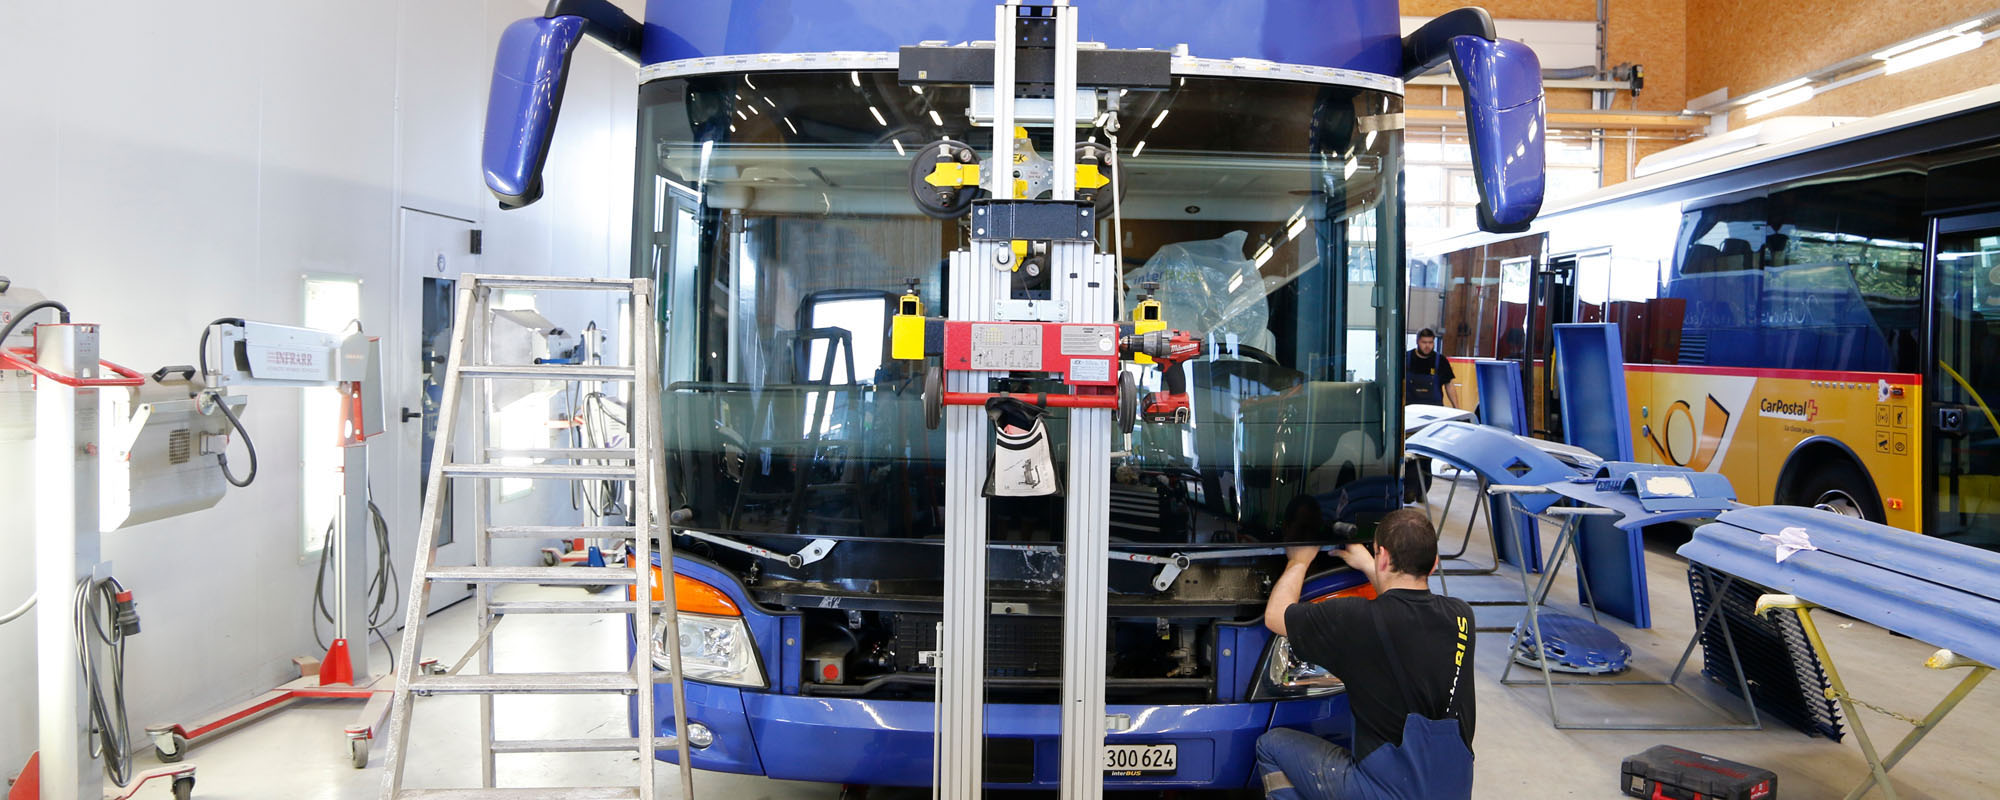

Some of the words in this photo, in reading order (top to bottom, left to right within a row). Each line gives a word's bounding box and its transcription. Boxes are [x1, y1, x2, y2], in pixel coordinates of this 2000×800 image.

[1760, 398, 1807, 416] CarPostal
[1107, 749, 1138, 767] 300
[1142, 748, 1174, 767] 624
